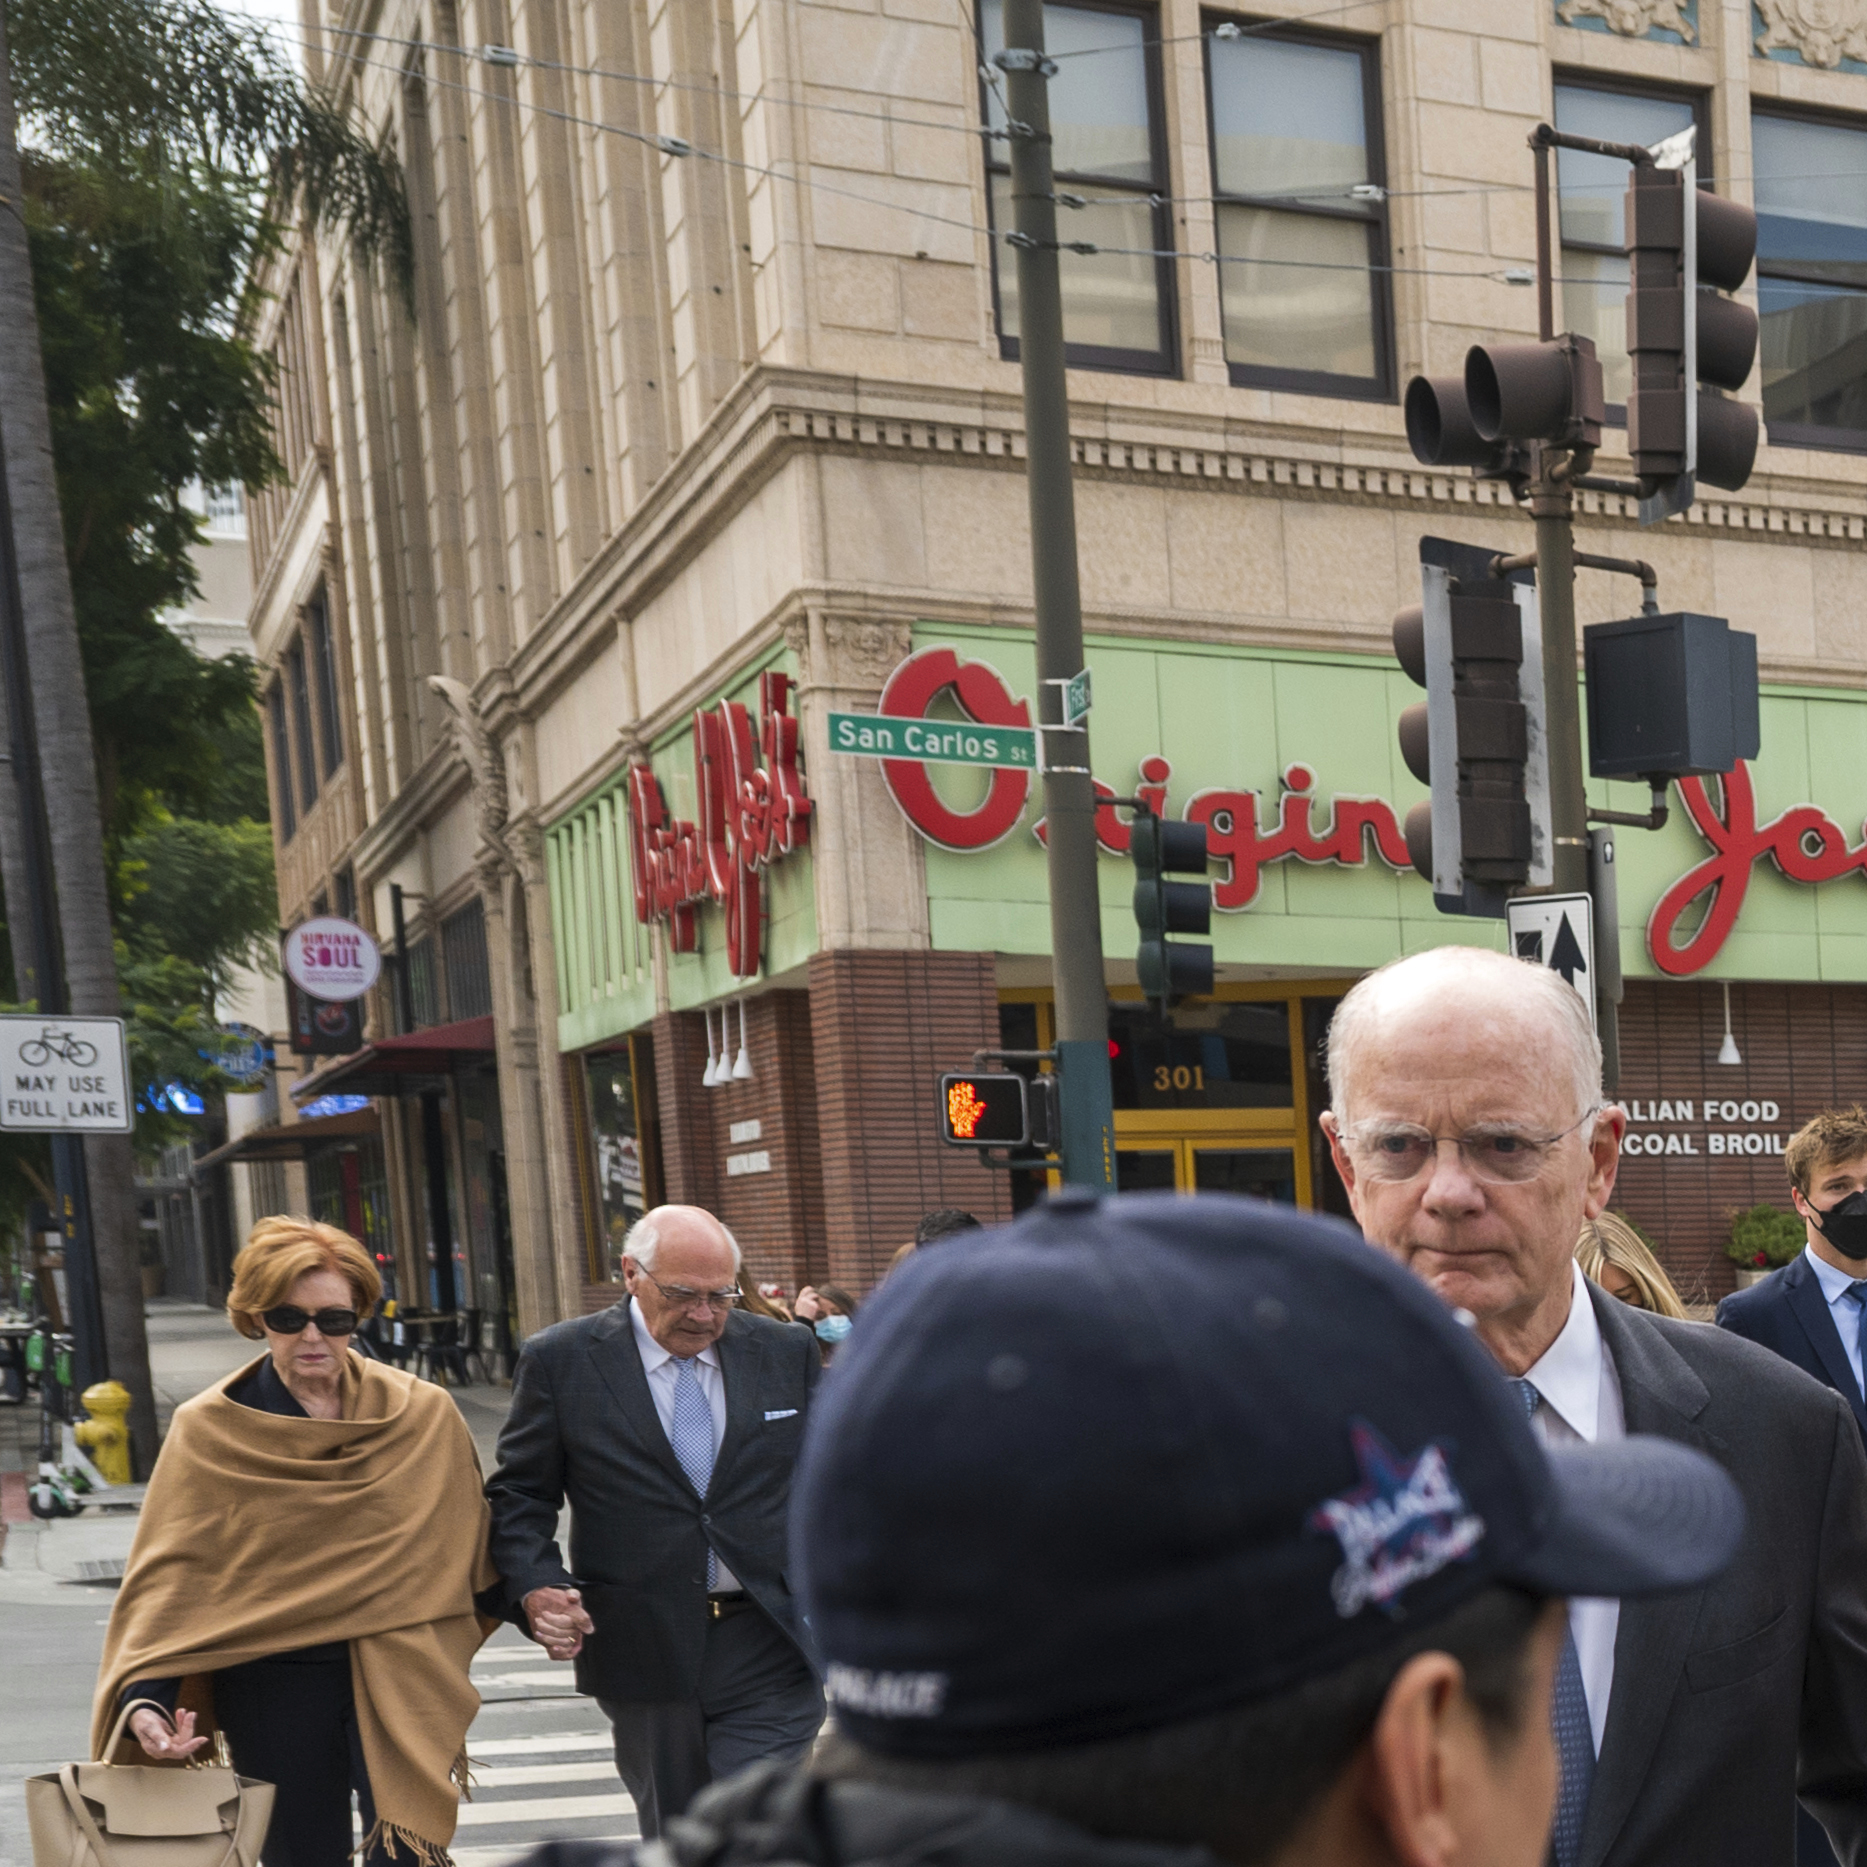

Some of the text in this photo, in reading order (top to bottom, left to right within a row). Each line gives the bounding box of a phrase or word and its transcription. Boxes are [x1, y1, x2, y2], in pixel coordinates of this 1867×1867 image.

[838, 720, 893, 749] San
[904, 726, 999, 759] Carlos
[1010, 746, 1029, 762] St
[878, 645, 1416, 912] Origin
[301, 931, 362, 947] NIRVANA
[303, 946, 362, 968] SOUL
[15, 1075, 106, 1094] MAY USE
[1154, 1065, 1204, 1091] 301
[8, 1100, 118, 1118] FULL LANE
[1616, 1100, 1780, 1122] ALIAN FOOD
[1619, 1133, 1797, 1155] COAL BROIL
